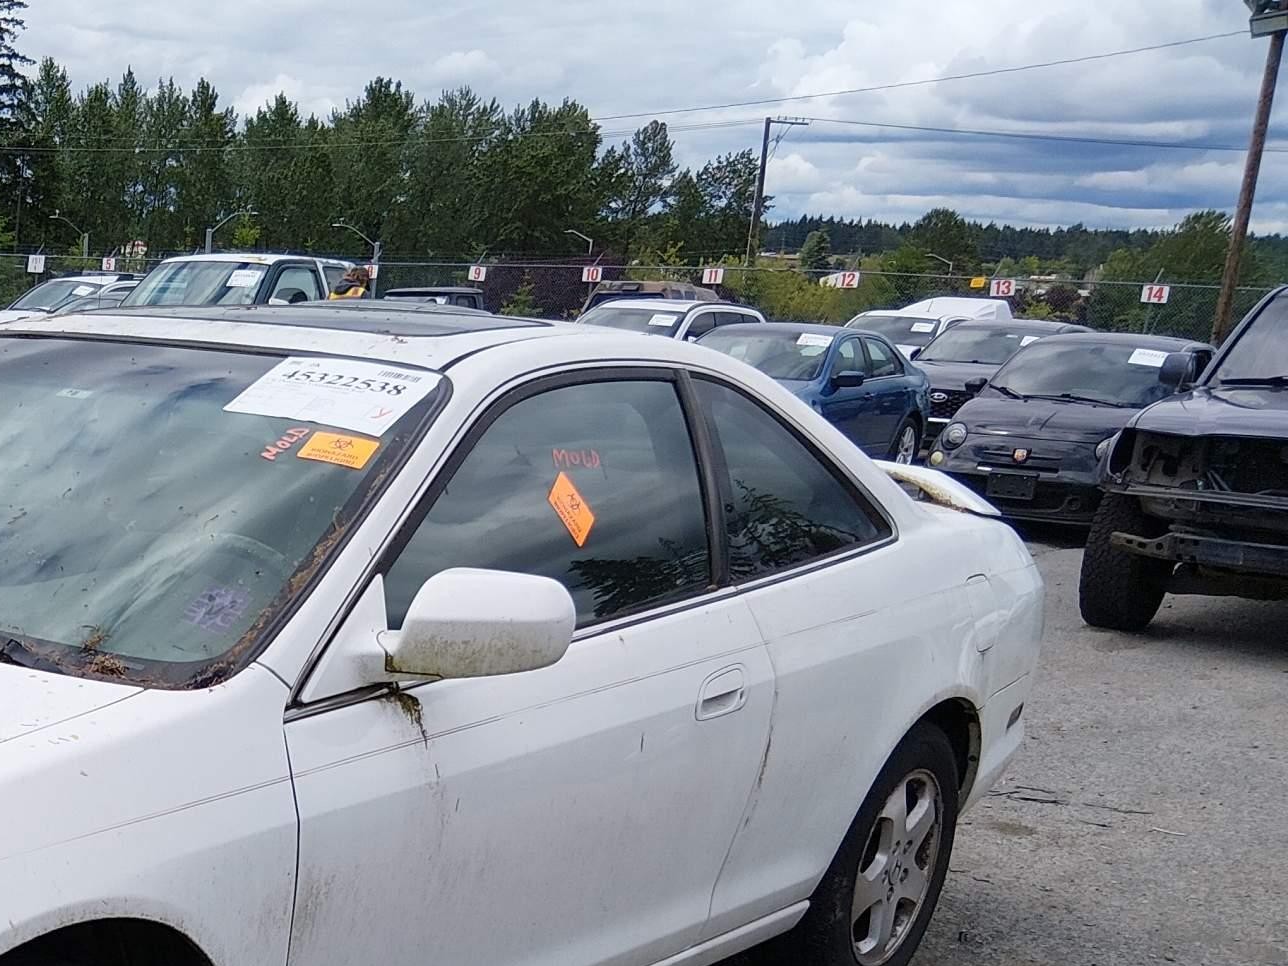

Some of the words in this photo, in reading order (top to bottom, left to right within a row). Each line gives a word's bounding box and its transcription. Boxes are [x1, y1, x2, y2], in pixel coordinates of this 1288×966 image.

[105, 257, 112, 270] 5
[473, 267, 482, 280] 9
[586, 266, 599, 281] 10
[708, 268, 718, 283] 11
[840, 273, 856, 287] 12
[994, 280, 1011, 295] 13
[1146, 286, 1164, 302] 14
[281, 368, 408, 397] 45322538
